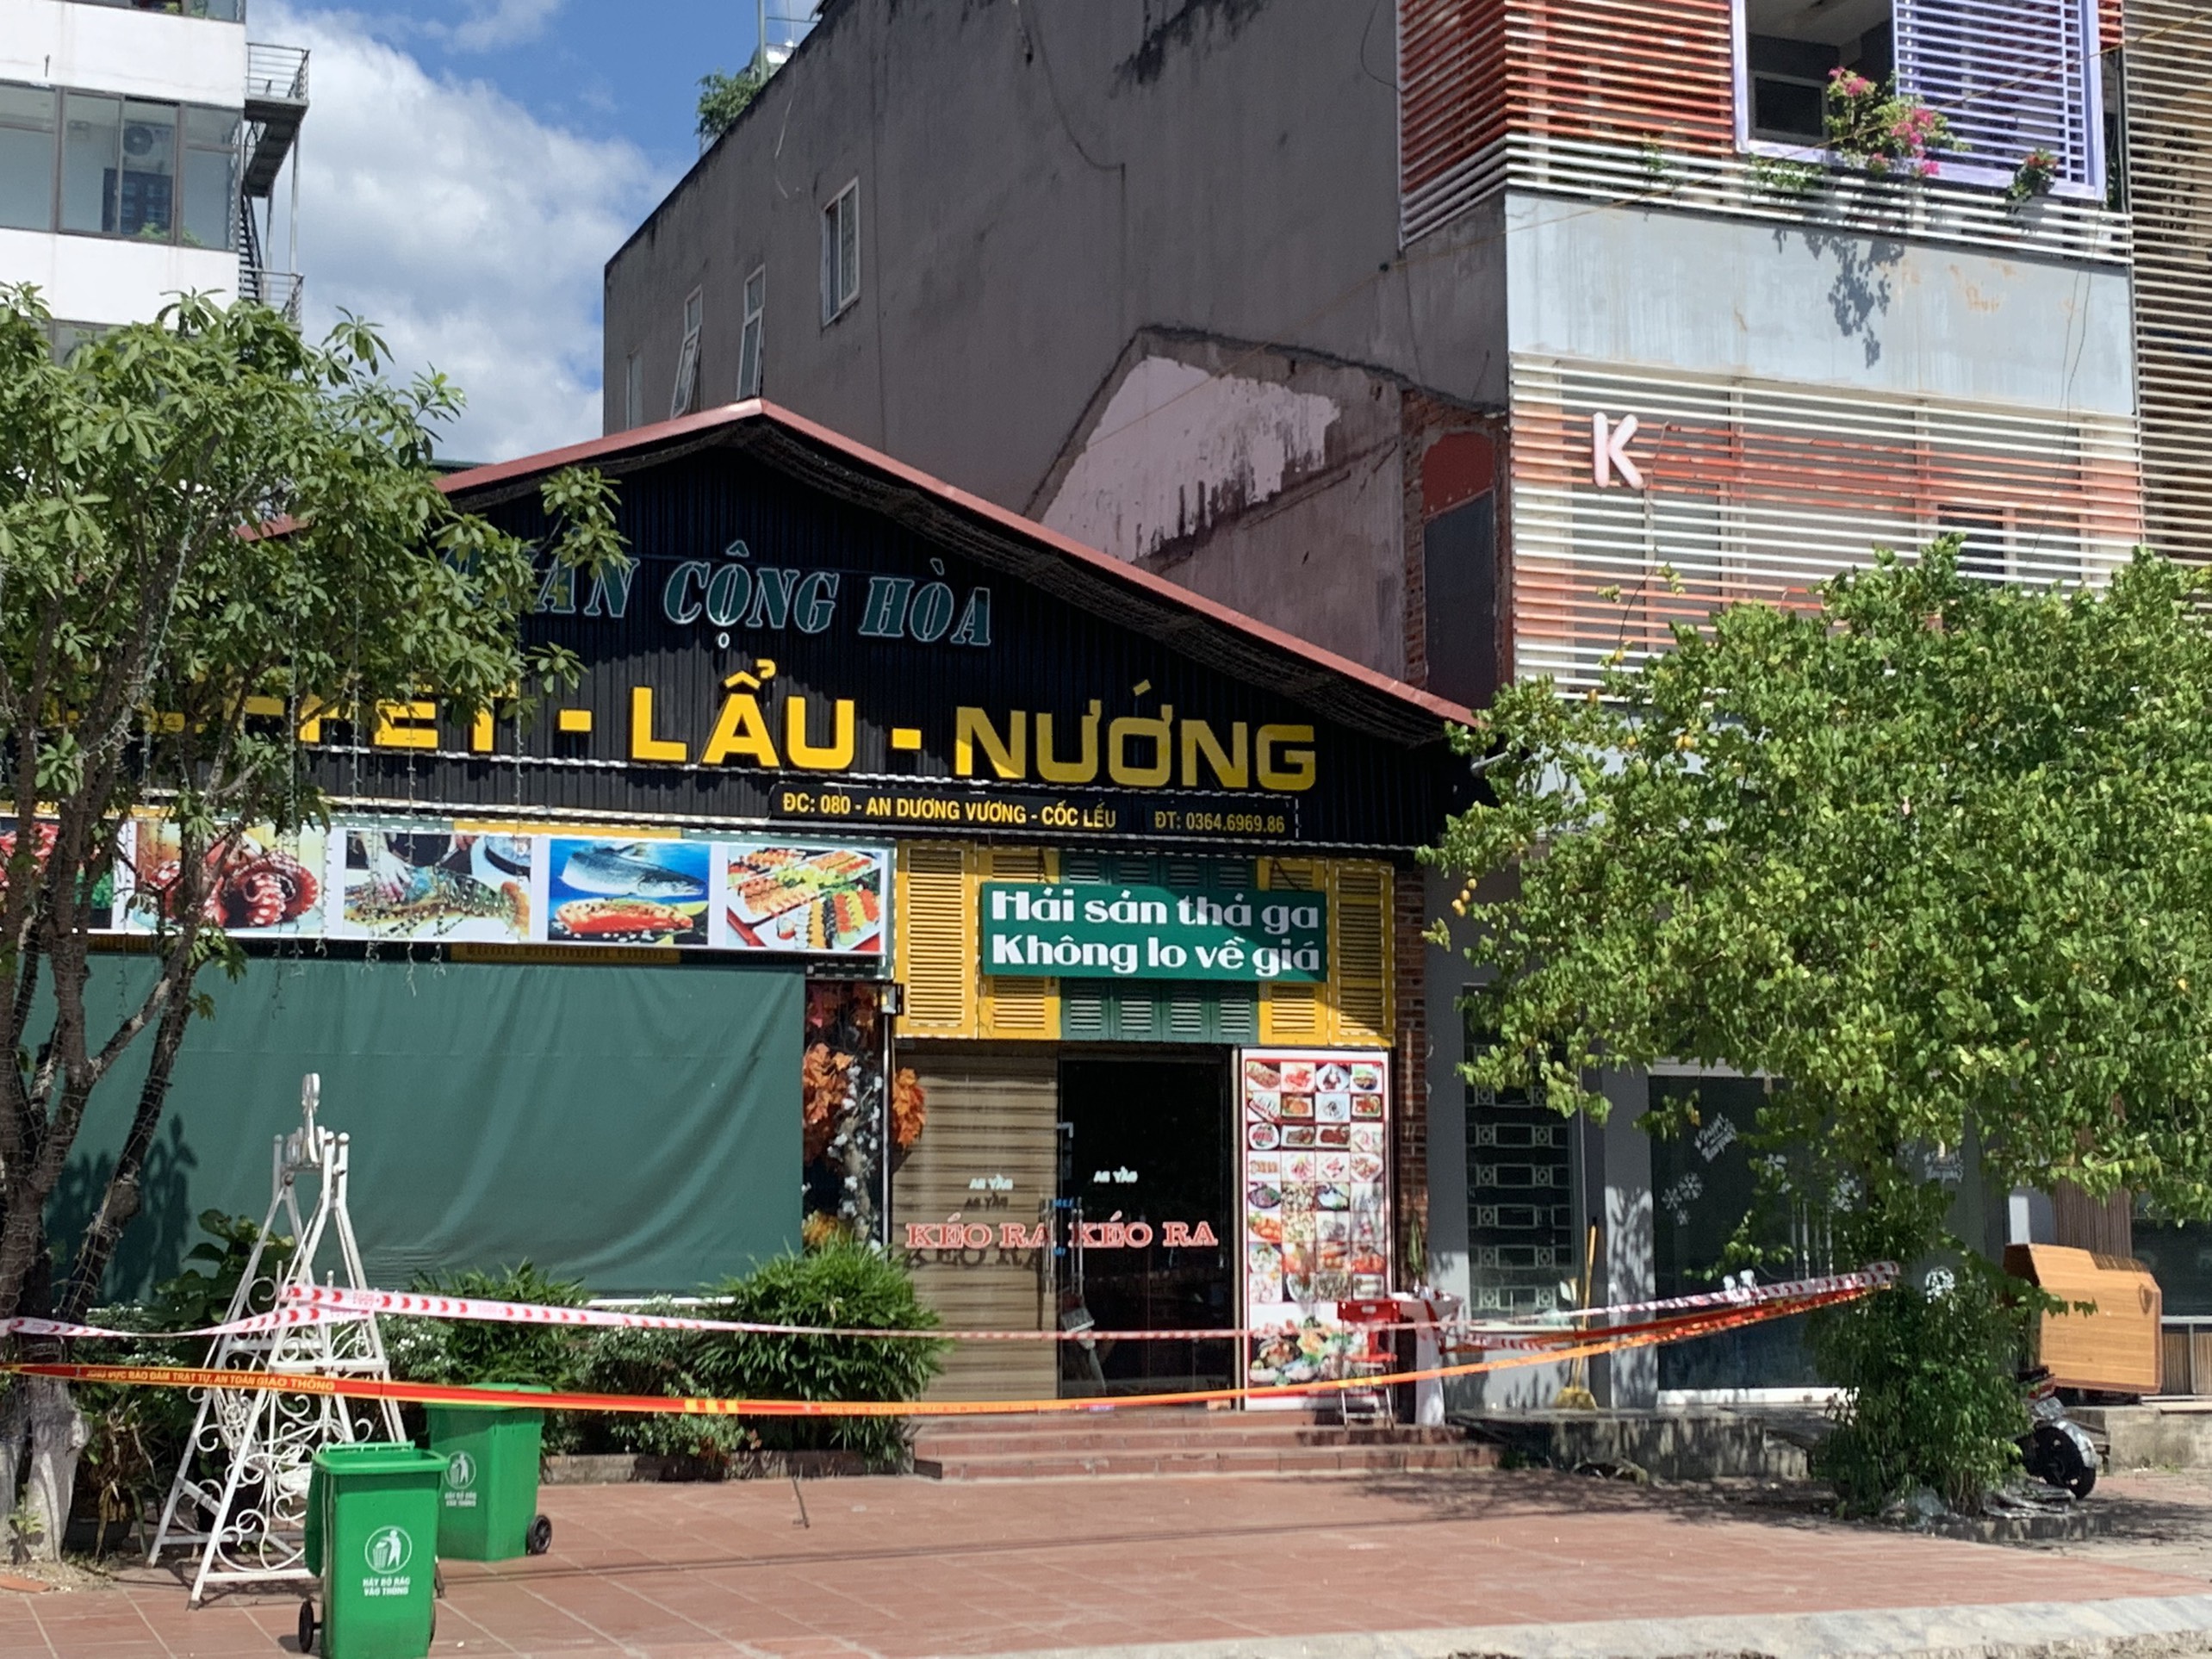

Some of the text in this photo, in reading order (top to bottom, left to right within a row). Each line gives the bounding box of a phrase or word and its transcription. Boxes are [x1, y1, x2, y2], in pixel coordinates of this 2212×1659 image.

[1593, 412, 1643, 490] K
[663, 539, 840, 649] CỘNG
[858, 557, 991, 647] HÒA
[631, 659, 856, 771] LẨU
[956, 679, 1316, 791] NƯỚNG
[782, 792, 816, 813] ĐC:
[820, 794, 851, 815] 080
[866, 797, 892, 817] AN
[897, 796, 960, 820] DƯƠNG
[966, 799, 1027, 824] VƯƠNG
[1041, 799, 1078, 827] CỐC
[1083, 802, 1116, 829] LẾU
[1155, 811, 1181, 830] ĐT:
[1185, 811, 1285, 834] 0364.6969.86
[992, 887, 1319, 935] Hải sản thả ga
[992, 934, 1320, 978] Không lo về giá
[904, 1210, 1057, 1250] KÉO RA
[1068, 1209, 1219, 1249] KÉO RA
[257, 1376, 288, 1388] GIAO
[290, 1376, 336, 1391] THÔNG
